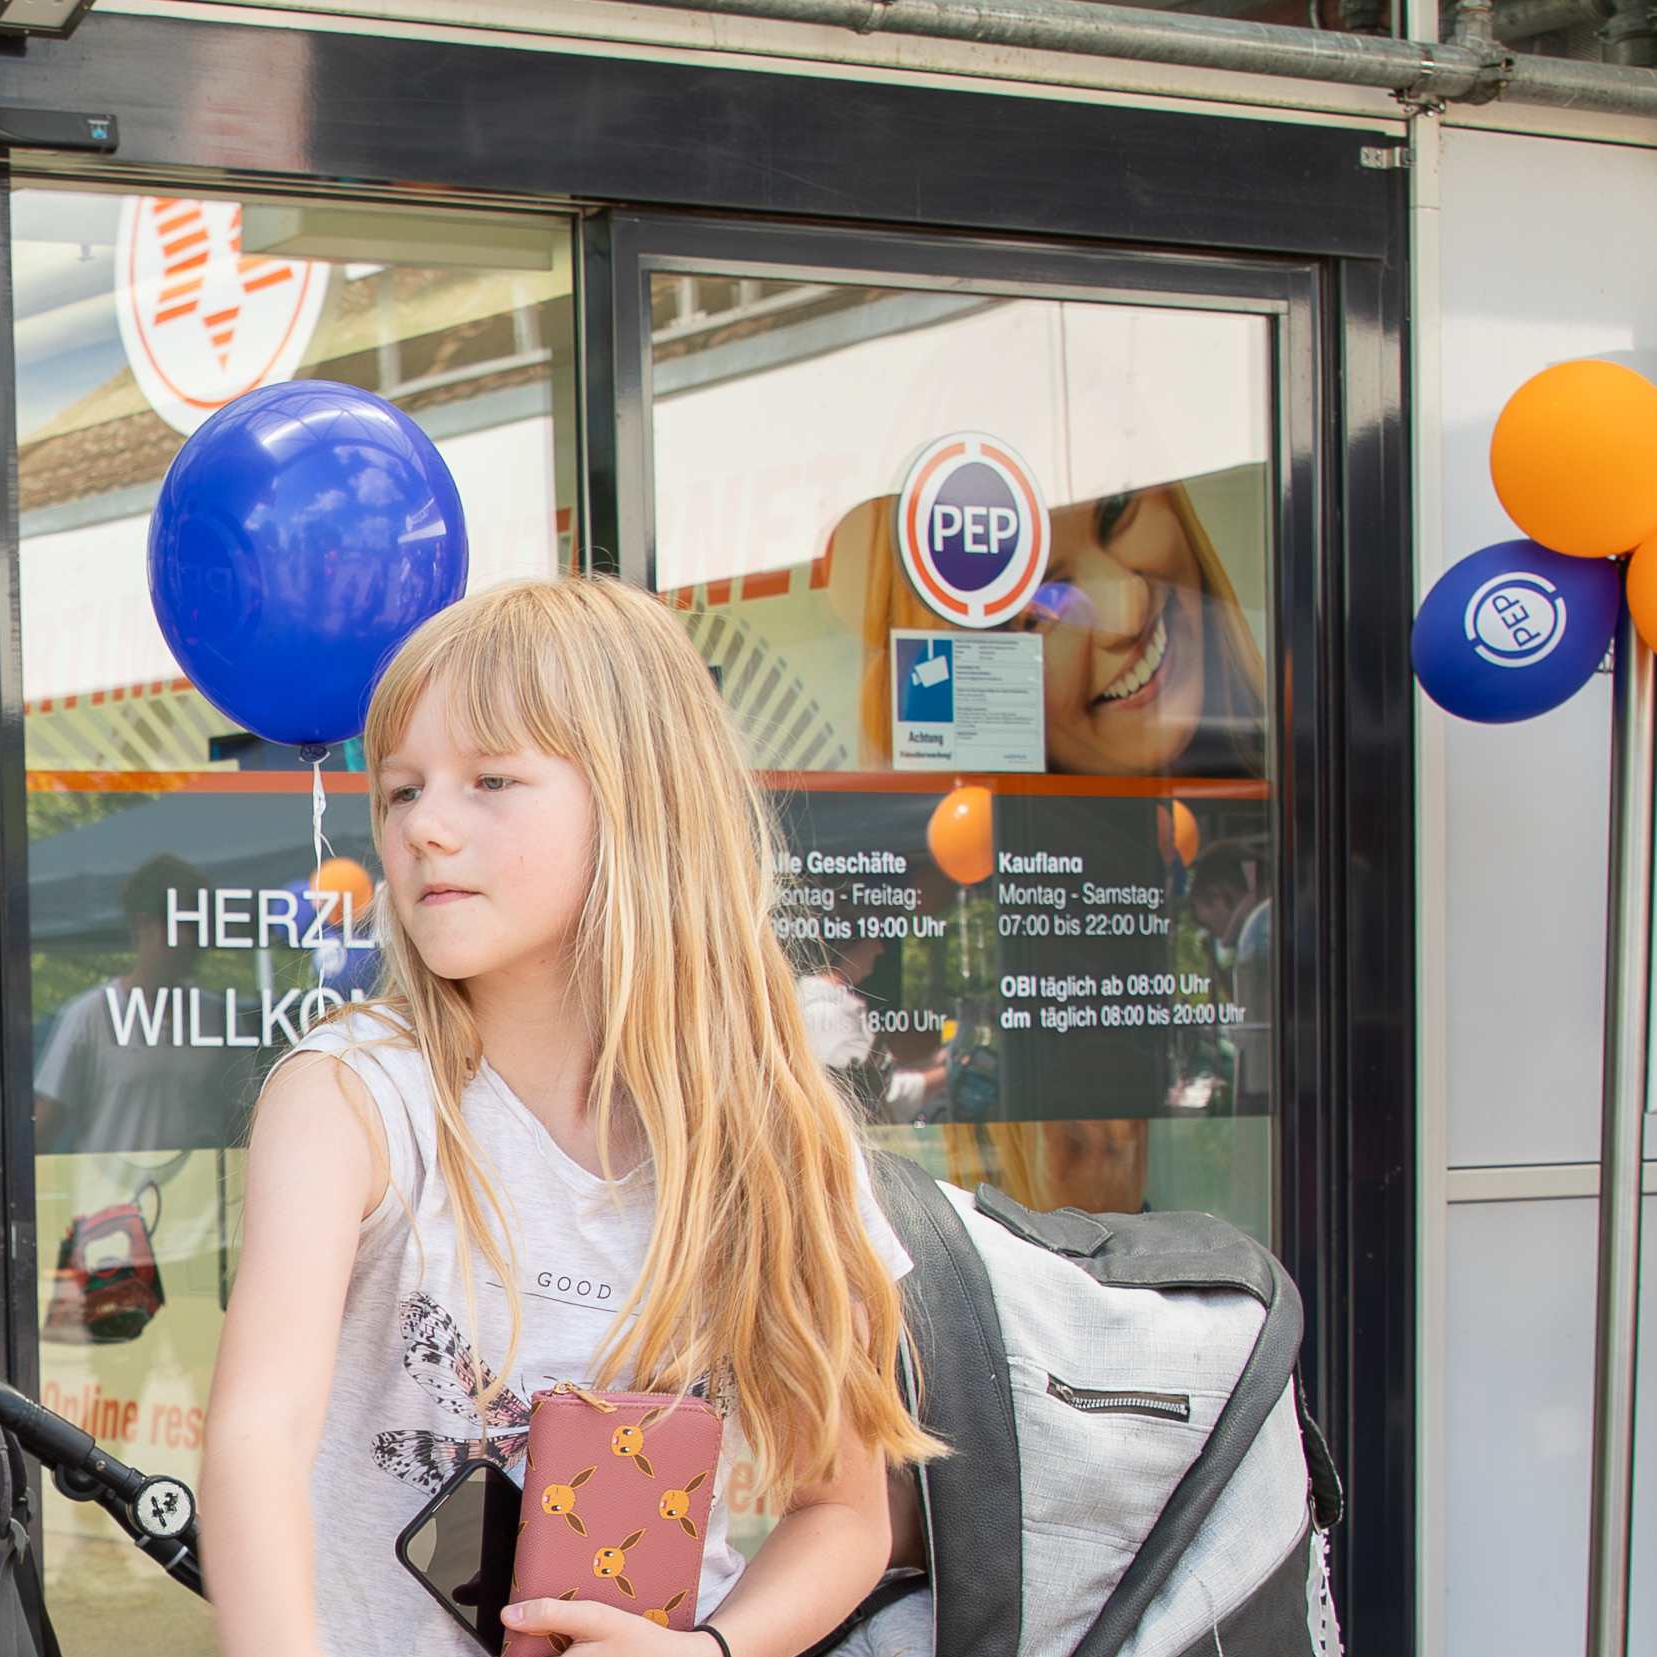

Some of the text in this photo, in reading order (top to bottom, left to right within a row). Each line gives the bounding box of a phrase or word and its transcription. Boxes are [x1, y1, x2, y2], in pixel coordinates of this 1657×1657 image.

[933, 505, 1020, 554] PEP
[1492, 595, 1541, 647] PEP
[908, 731, 944, 746] Achtung
[807, 851, 907, 874] Geschäfte
[781, 886, 835, 911] ontag
[852, 883, 922, 910] Freitag:
[998, 883, 1066, 909] Montag
[1082, 882, 1164, 909] Samstag:
[167, 888, 376, 948] HERZL
[824, 917, 851, 939] bis
[857, 916, 908, 938] 19:00
[913, 915, 946, 938] Uhr
[998, 913, 1171, 936] 07:00 bis 22:00 Uhr
[1000, 973, 1211, 1002] OBI täglich ab 08:00 Uhr
[105, 987, 368, 1047] WILLKO
[913, 1009, 946, 1032] Uhr
[1000, 1002, 1246, 1033] dm täglich 08:00 bis 20:00 Uhr
[537, 1271, 612, 1300] GOOD
